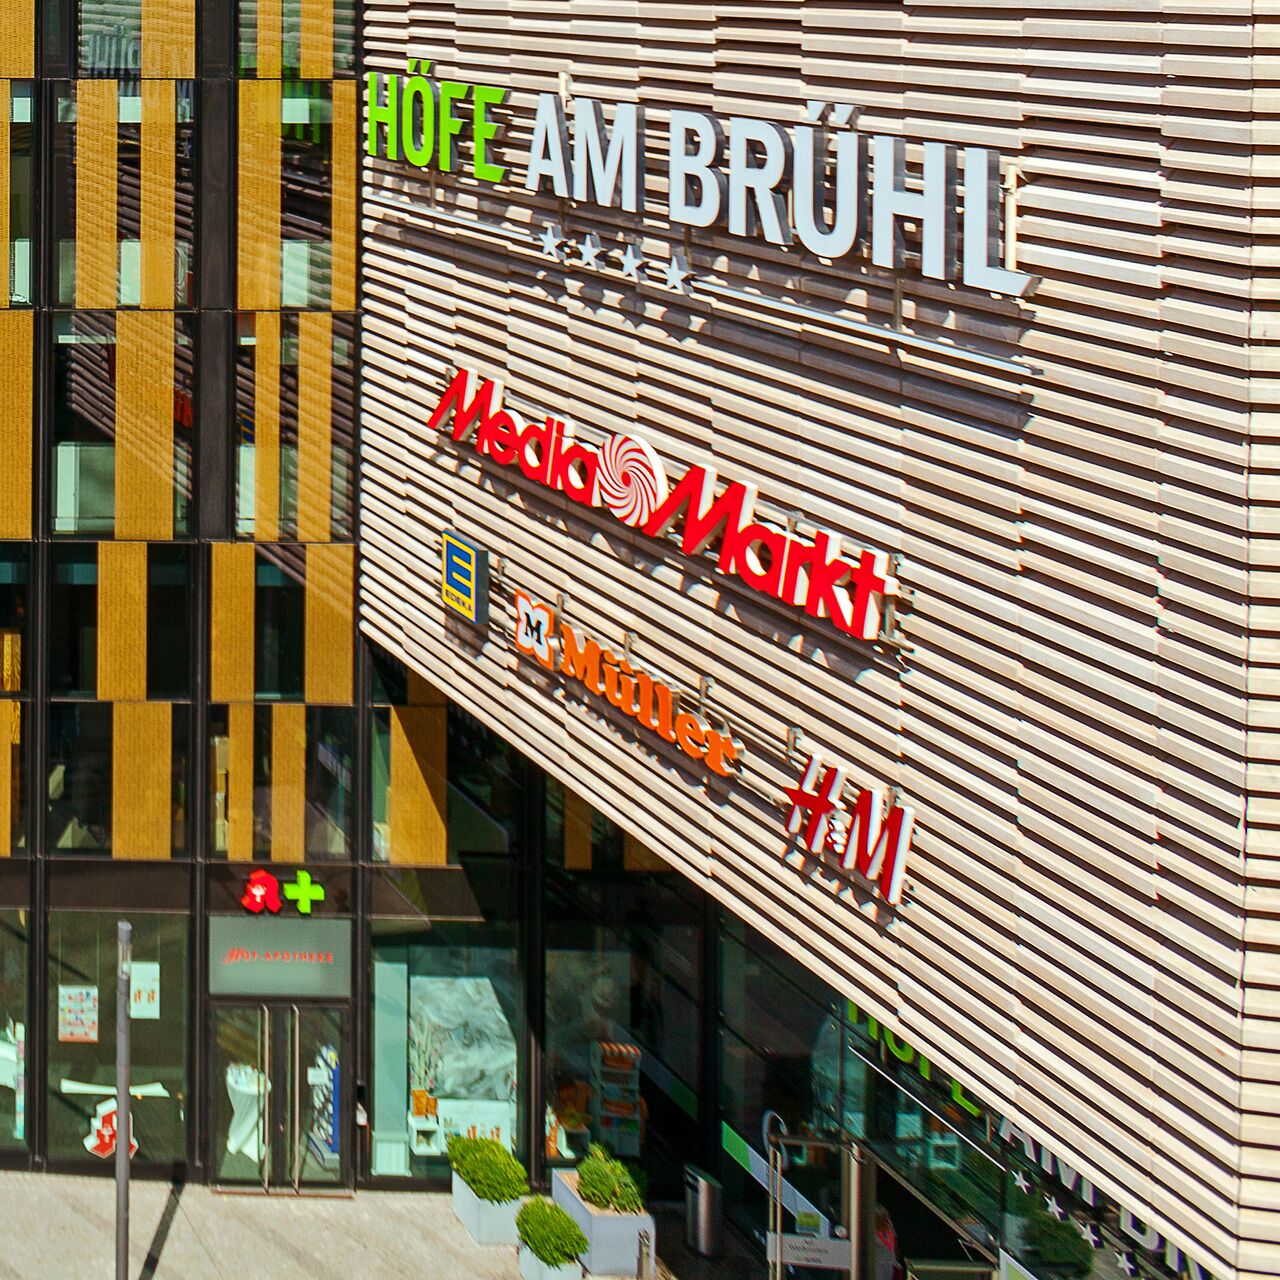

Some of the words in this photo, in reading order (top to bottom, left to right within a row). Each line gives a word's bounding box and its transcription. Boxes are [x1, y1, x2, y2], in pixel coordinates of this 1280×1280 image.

[366, 59, 511, 183] HÖFE
[525, 92, 646, 213] AM
[669, 100, 1041, 297] BRÜHL
[427, 367, 604, 508] Media
[649, 464, 901, 640] Markt
[561, 623, 744, 777] Müller
